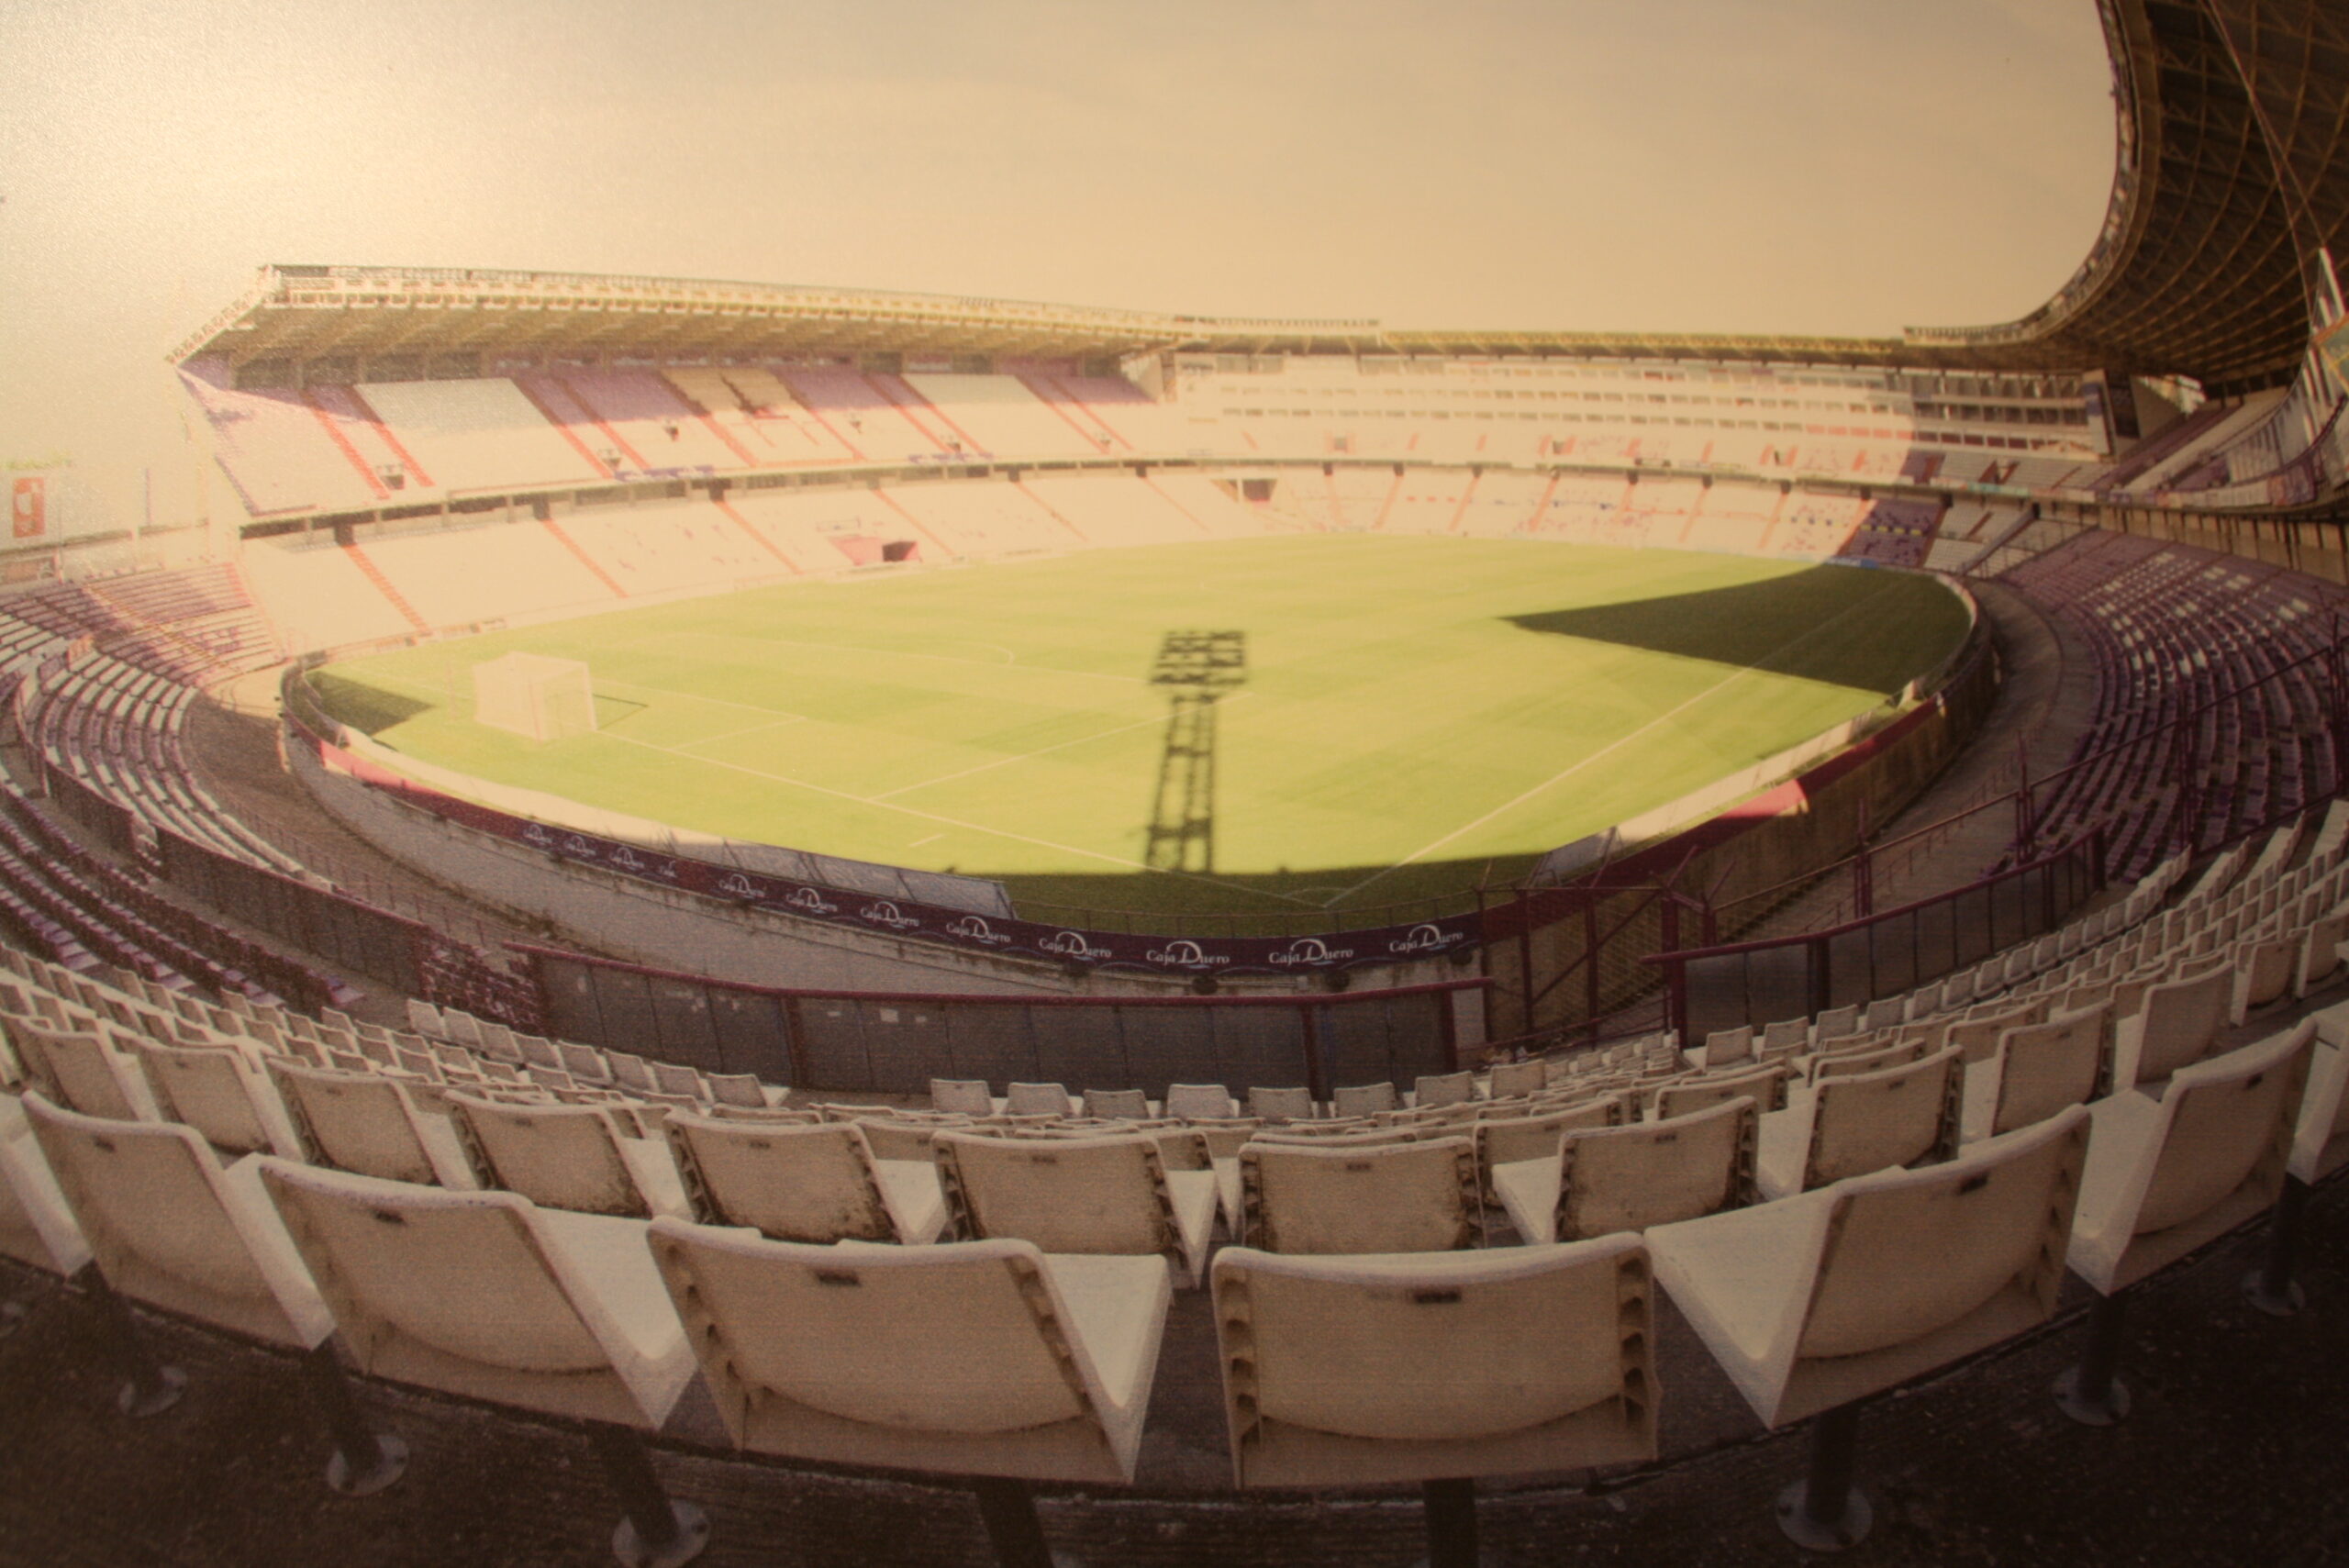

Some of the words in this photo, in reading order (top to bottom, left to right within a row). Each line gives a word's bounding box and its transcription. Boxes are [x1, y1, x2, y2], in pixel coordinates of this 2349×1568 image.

[946, 921, 970, 938] Caja
[1389, 940, 1418, 953] Caja
[1408, 924, 1464, 947] Duero
[1039, 938, 1064, 954] Caja
[1056, 930, 1112, 958] Duero
[1147, 950, 1175, 965] Caja
[1166, 940, 1230, 963] Duero
[1268, 951, 1300, 966] Caja
[1290, 938, 1353, 962] Duero
